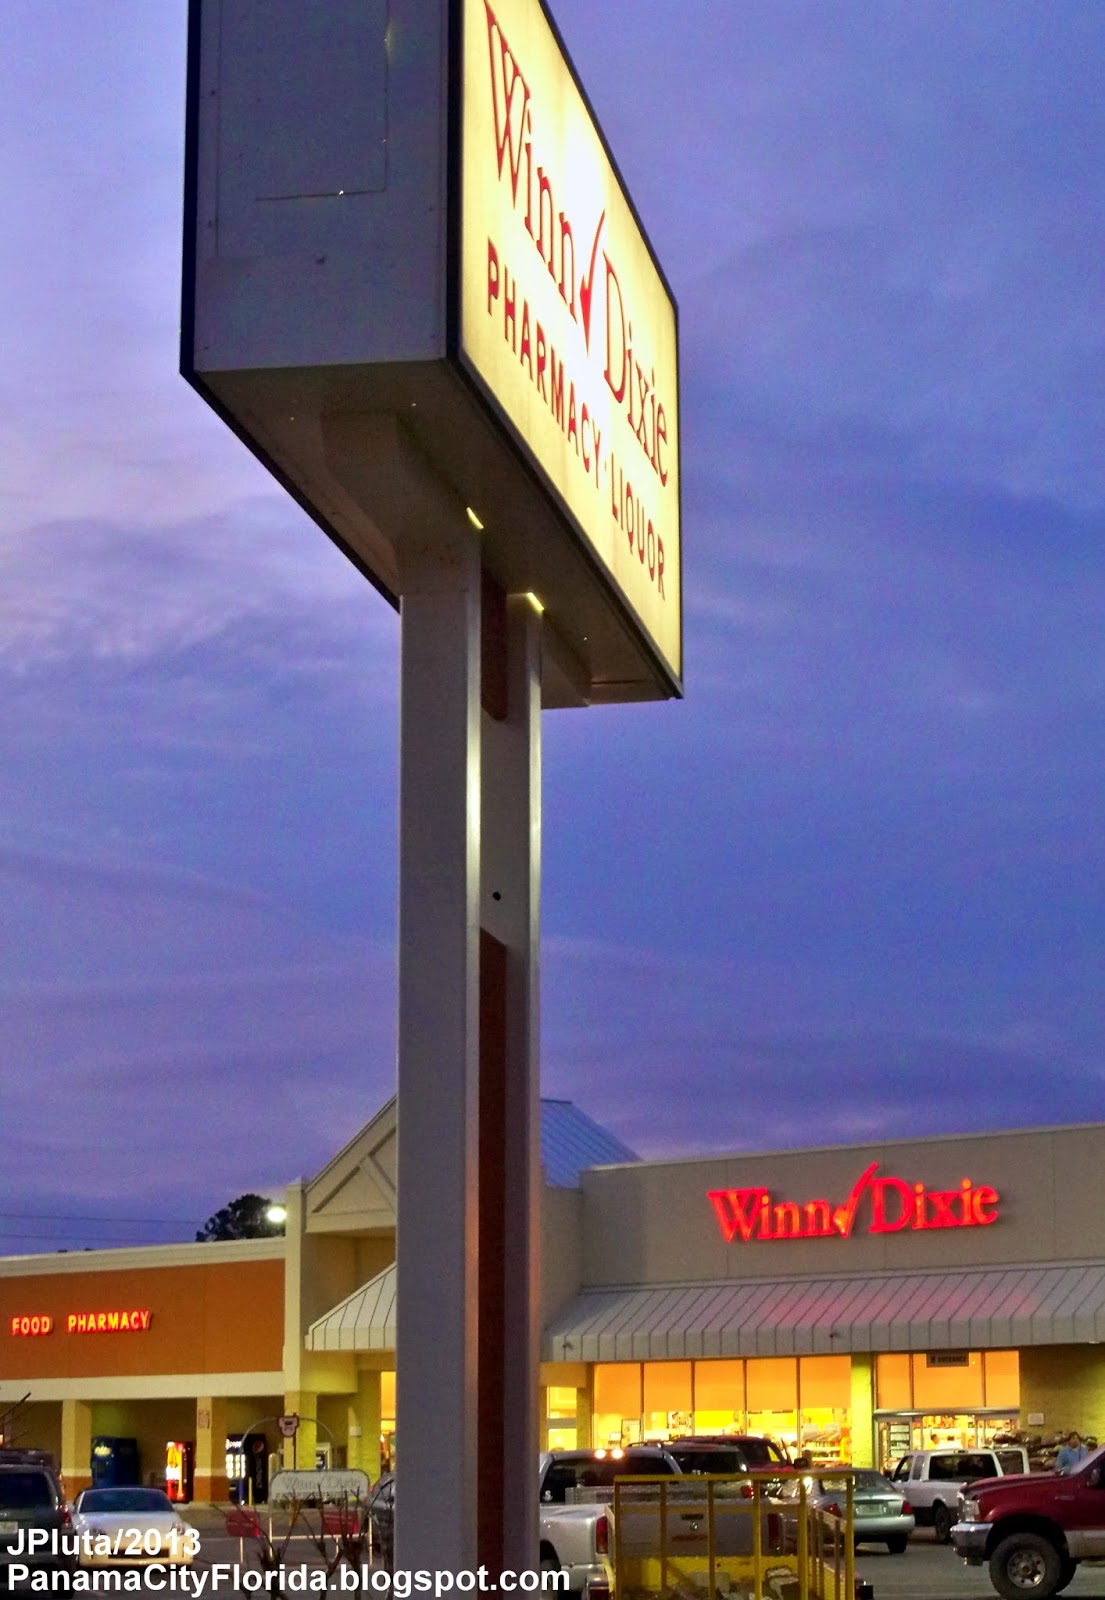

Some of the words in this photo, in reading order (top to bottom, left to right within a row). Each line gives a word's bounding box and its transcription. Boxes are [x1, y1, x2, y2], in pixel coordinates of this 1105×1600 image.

[484, 0, 578, 325] Winn
[602, 248, 668, 487] Dixie
[487, 235, 601, 489] PHARMACY
[611, 452, 666, 600] LIQUOR
[706, 1186, 835, 1243] Winn
[866, 1176, 999, 1232] Dixie
[11, 1315, 53, 1336] FOOD
[67, 1310, 151, 1333] PHARMACY
